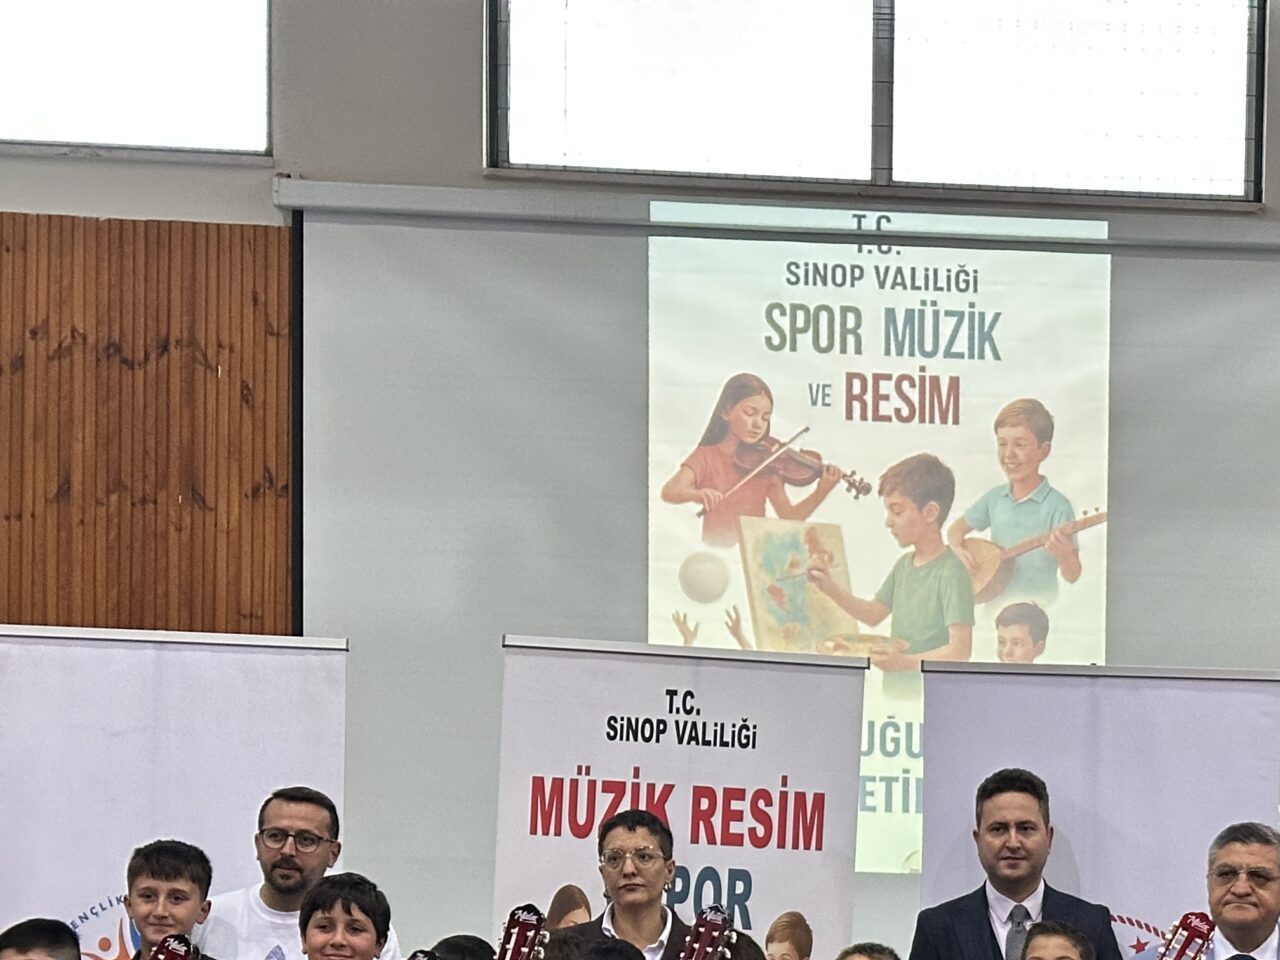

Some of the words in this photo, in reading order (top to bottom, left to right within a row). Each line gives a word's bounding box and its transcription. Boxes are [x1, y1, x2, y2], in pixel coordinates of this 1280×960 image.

[764, 302, 863, 355] SPOR
[883, 300, 1002, 361] MÜZİK
[808, 383, 832, 408] VE
[845, 366, 960, 426] RESİM
[665, 689, 701, 716] T.C.
[690, 775, 826, 852] RESİM
[70, 894, 125, 931] ENÇLİK
[664, 864, 753, 931] POR
